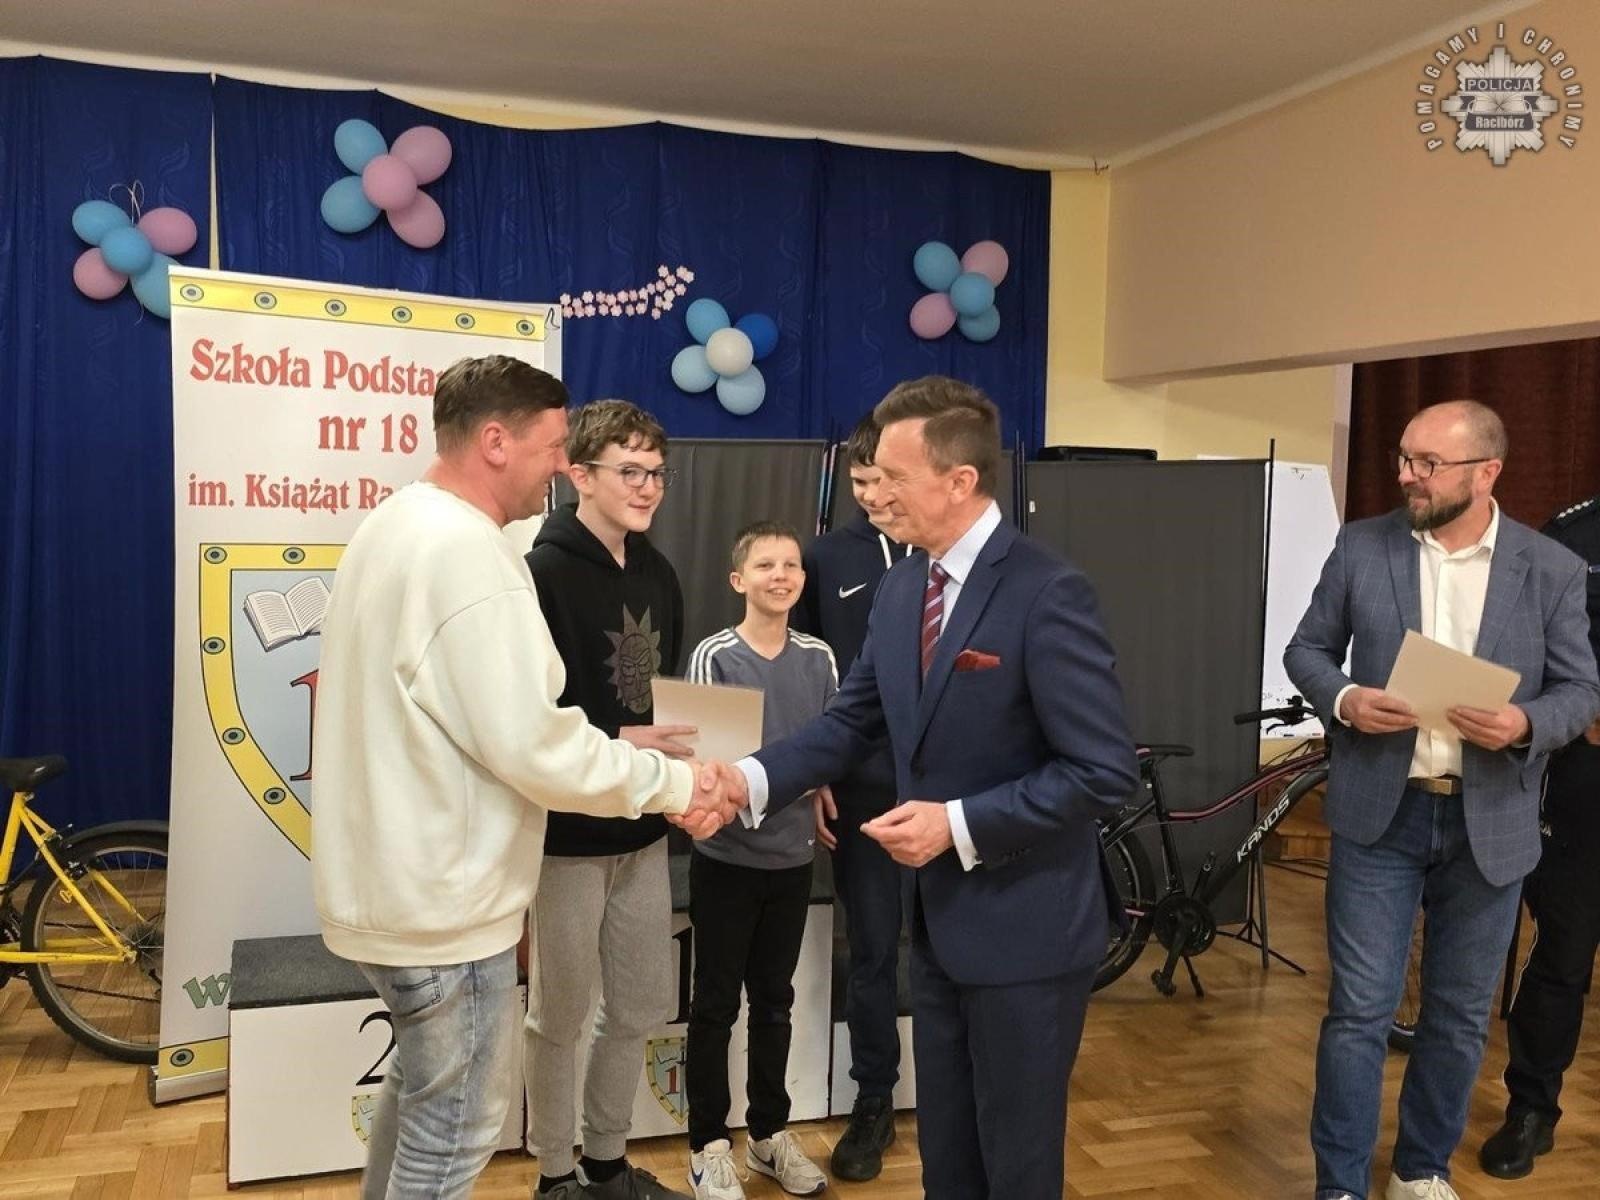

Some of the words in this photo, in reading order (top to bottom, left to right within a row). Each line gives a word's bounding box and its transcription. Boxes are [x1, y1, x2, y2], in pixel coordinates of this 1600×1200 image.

[190, 338, 311, 389] Szkoła
[323, 350, 443, 396] Podsta
[318, 414, 367, 451] nr
[381, 413, 419, 454] 18
[187, 472, 235, 506] im.
[245, 473, 350, 515] Książąt
[1236, 794, 1290, 863] KANDS
[355, 1010, 397, 1086] 2
